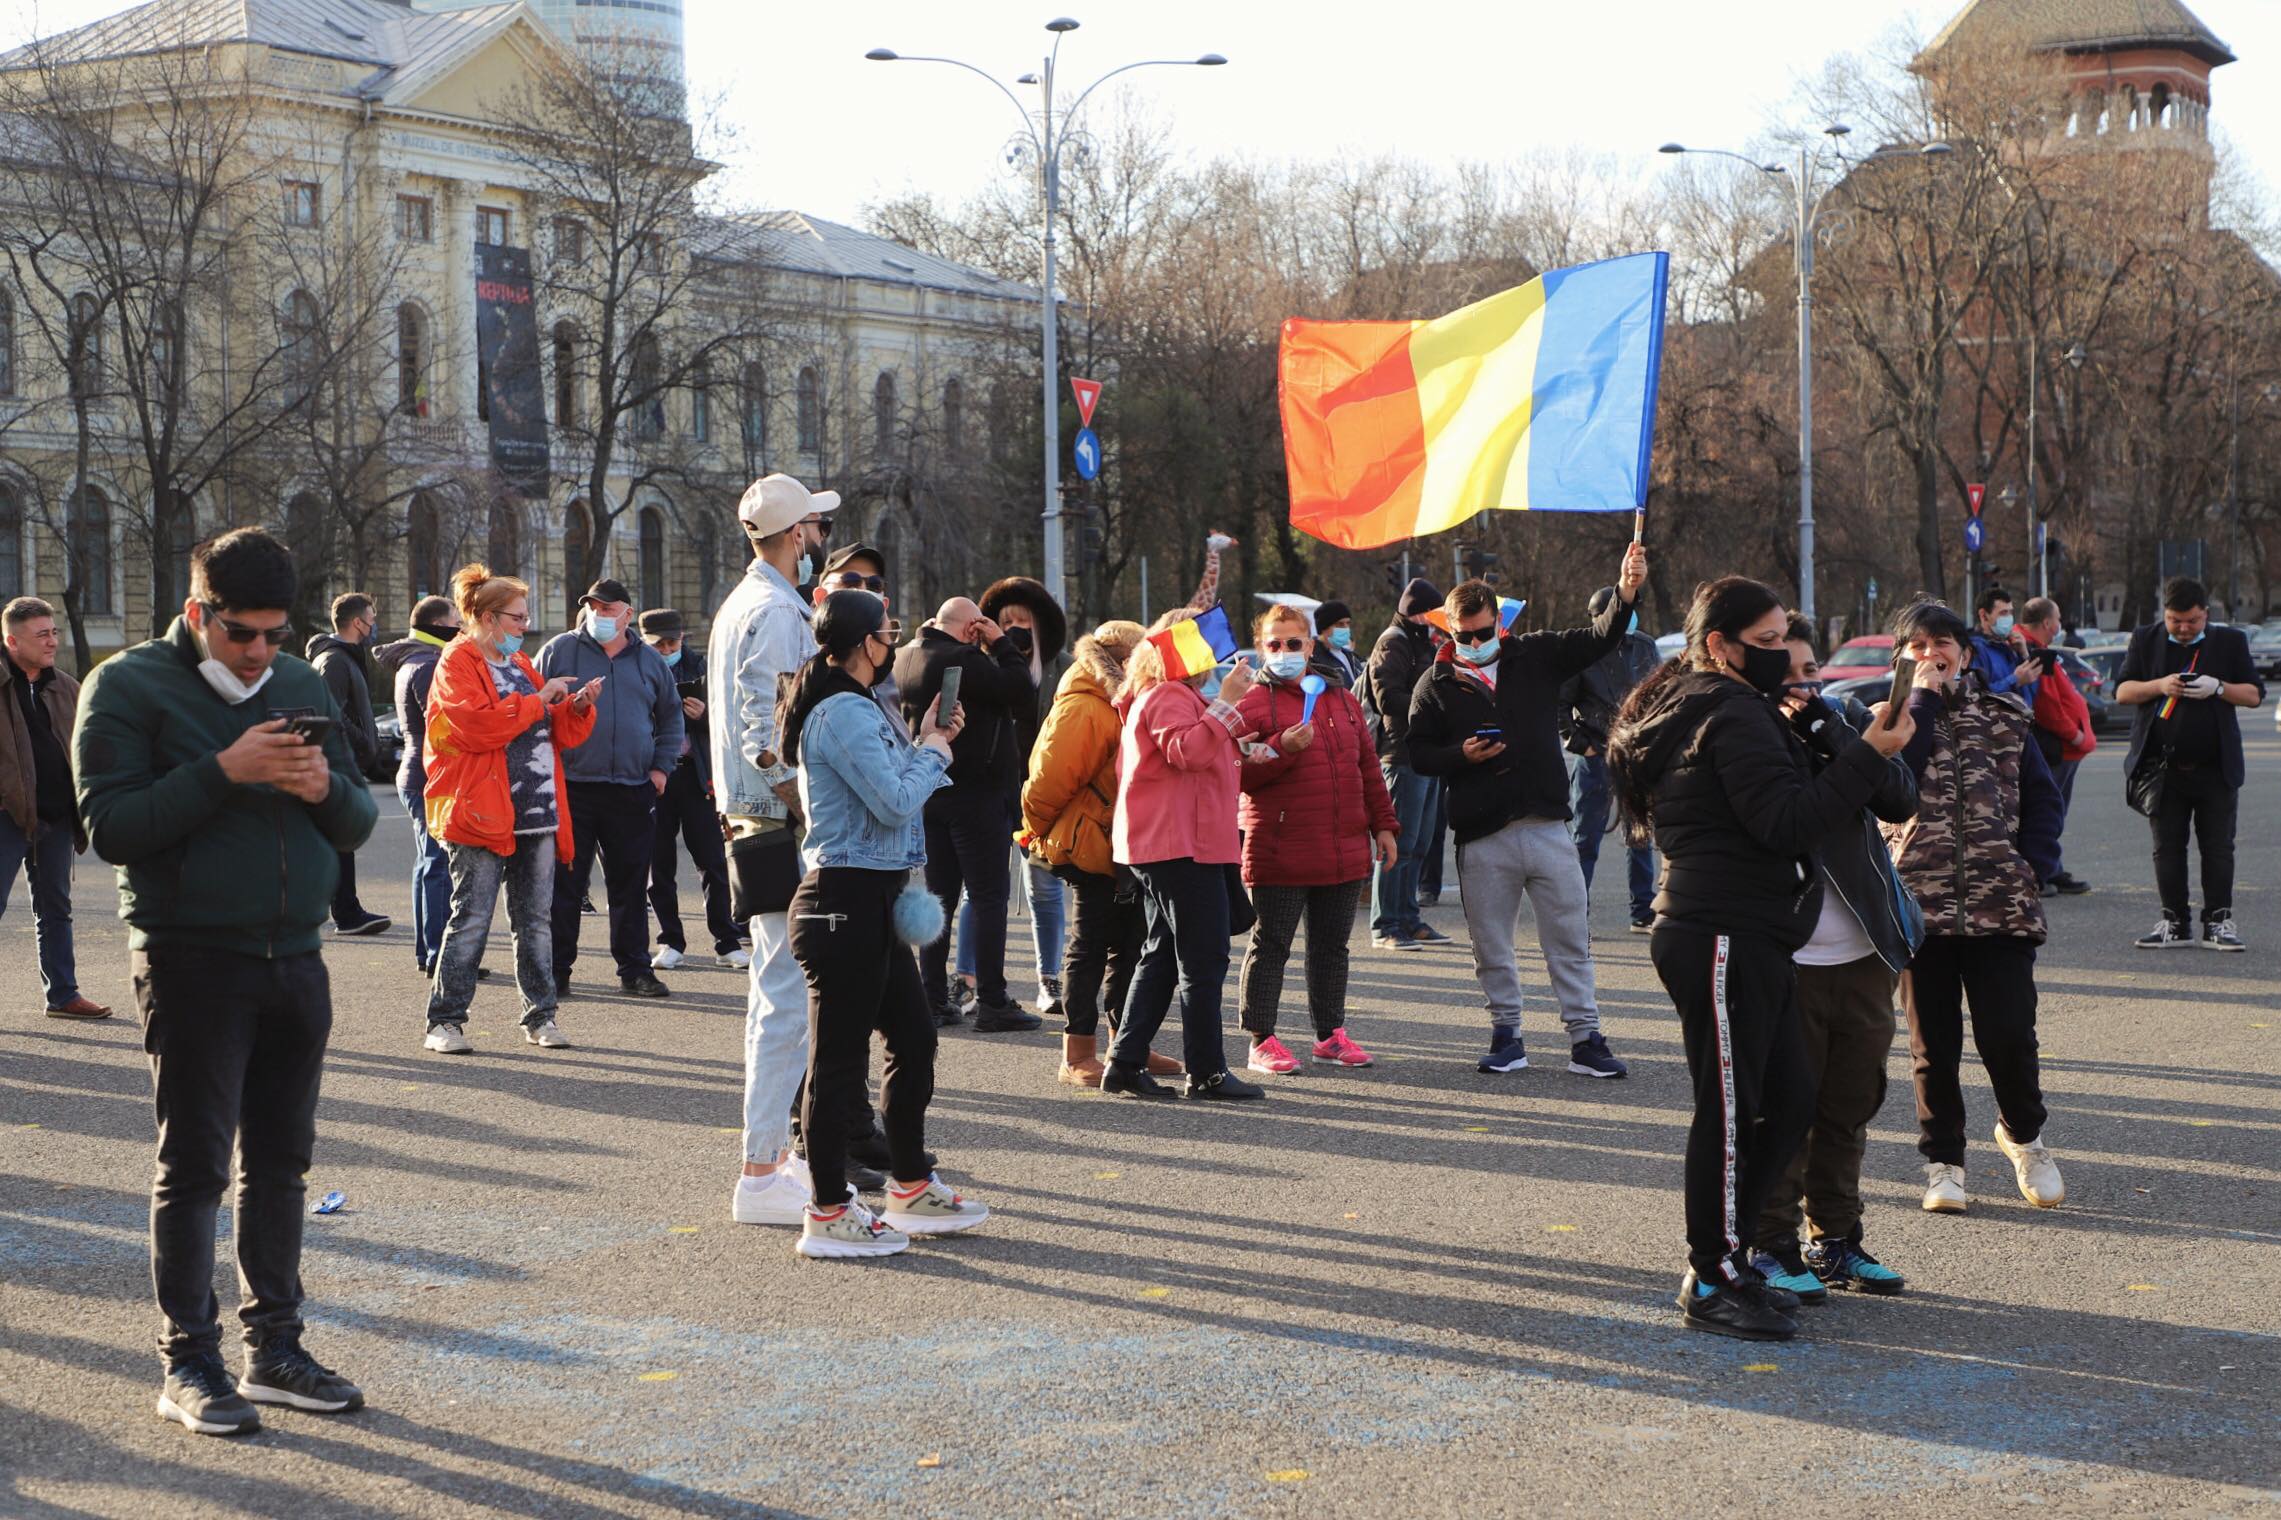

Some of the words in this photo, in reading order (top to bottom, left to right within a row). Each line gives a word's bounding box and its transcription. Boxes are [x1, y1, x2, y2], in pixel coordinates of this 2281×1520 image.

[400, 133, 439, 151] MUZEUL
[440, 140, 454, 154] DE
[1716, 965, 1725, 1005] HILFIGER
[1720, 1018, 1730, 1053] TOMMY
[1723, 1068, 1733, 1105] HILFIGER
